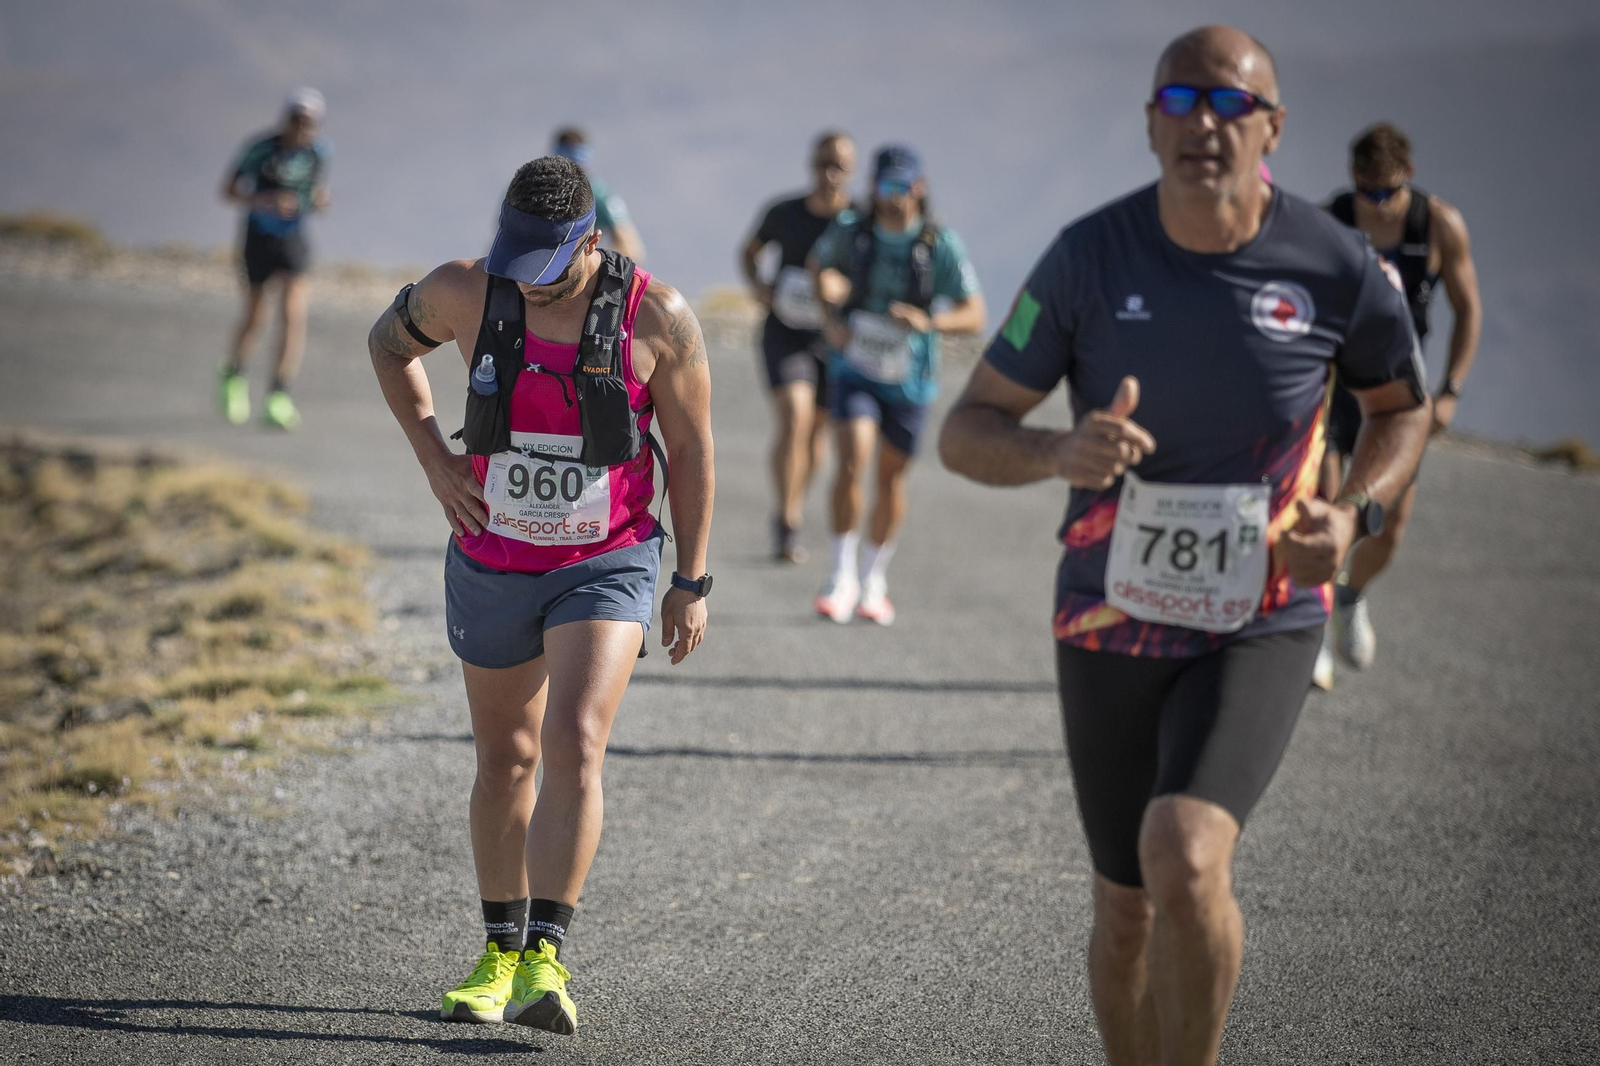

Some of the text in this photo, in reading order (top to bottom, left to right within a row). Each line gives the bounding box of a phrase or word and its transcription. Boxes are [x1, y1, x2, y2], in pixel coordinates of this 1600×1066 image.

[582, 365, 611, 374] EVADICT
[522, 442, 573, 454] XIX EDICIÓN
[507, 463, 583, 503] 960
[518, 510, 570, 519] GARCIA CRESPO
[1136, 524, 1229, 573] 781
